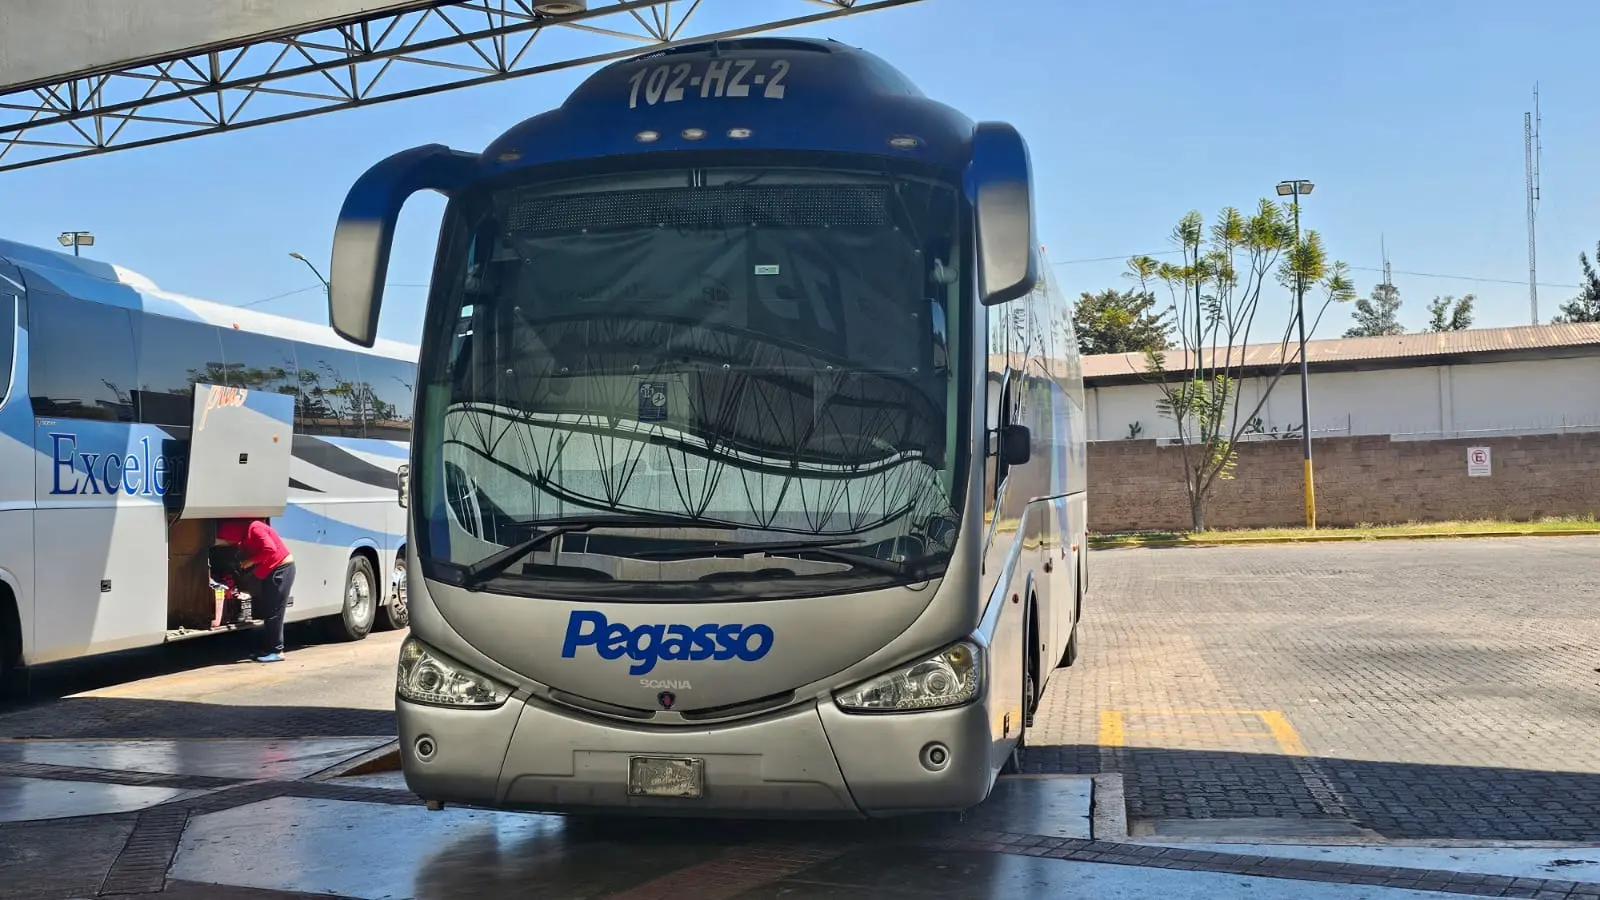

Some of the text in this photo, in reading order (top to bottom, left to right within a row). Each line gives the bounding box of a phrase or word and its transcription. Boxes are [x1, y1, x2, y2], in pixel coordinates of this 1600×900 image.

[628, 59, 790, 108] 102-HZ-2
[562, 610, 774, 675] Pegasso
[639, 679, 692, 692] SCANIA
